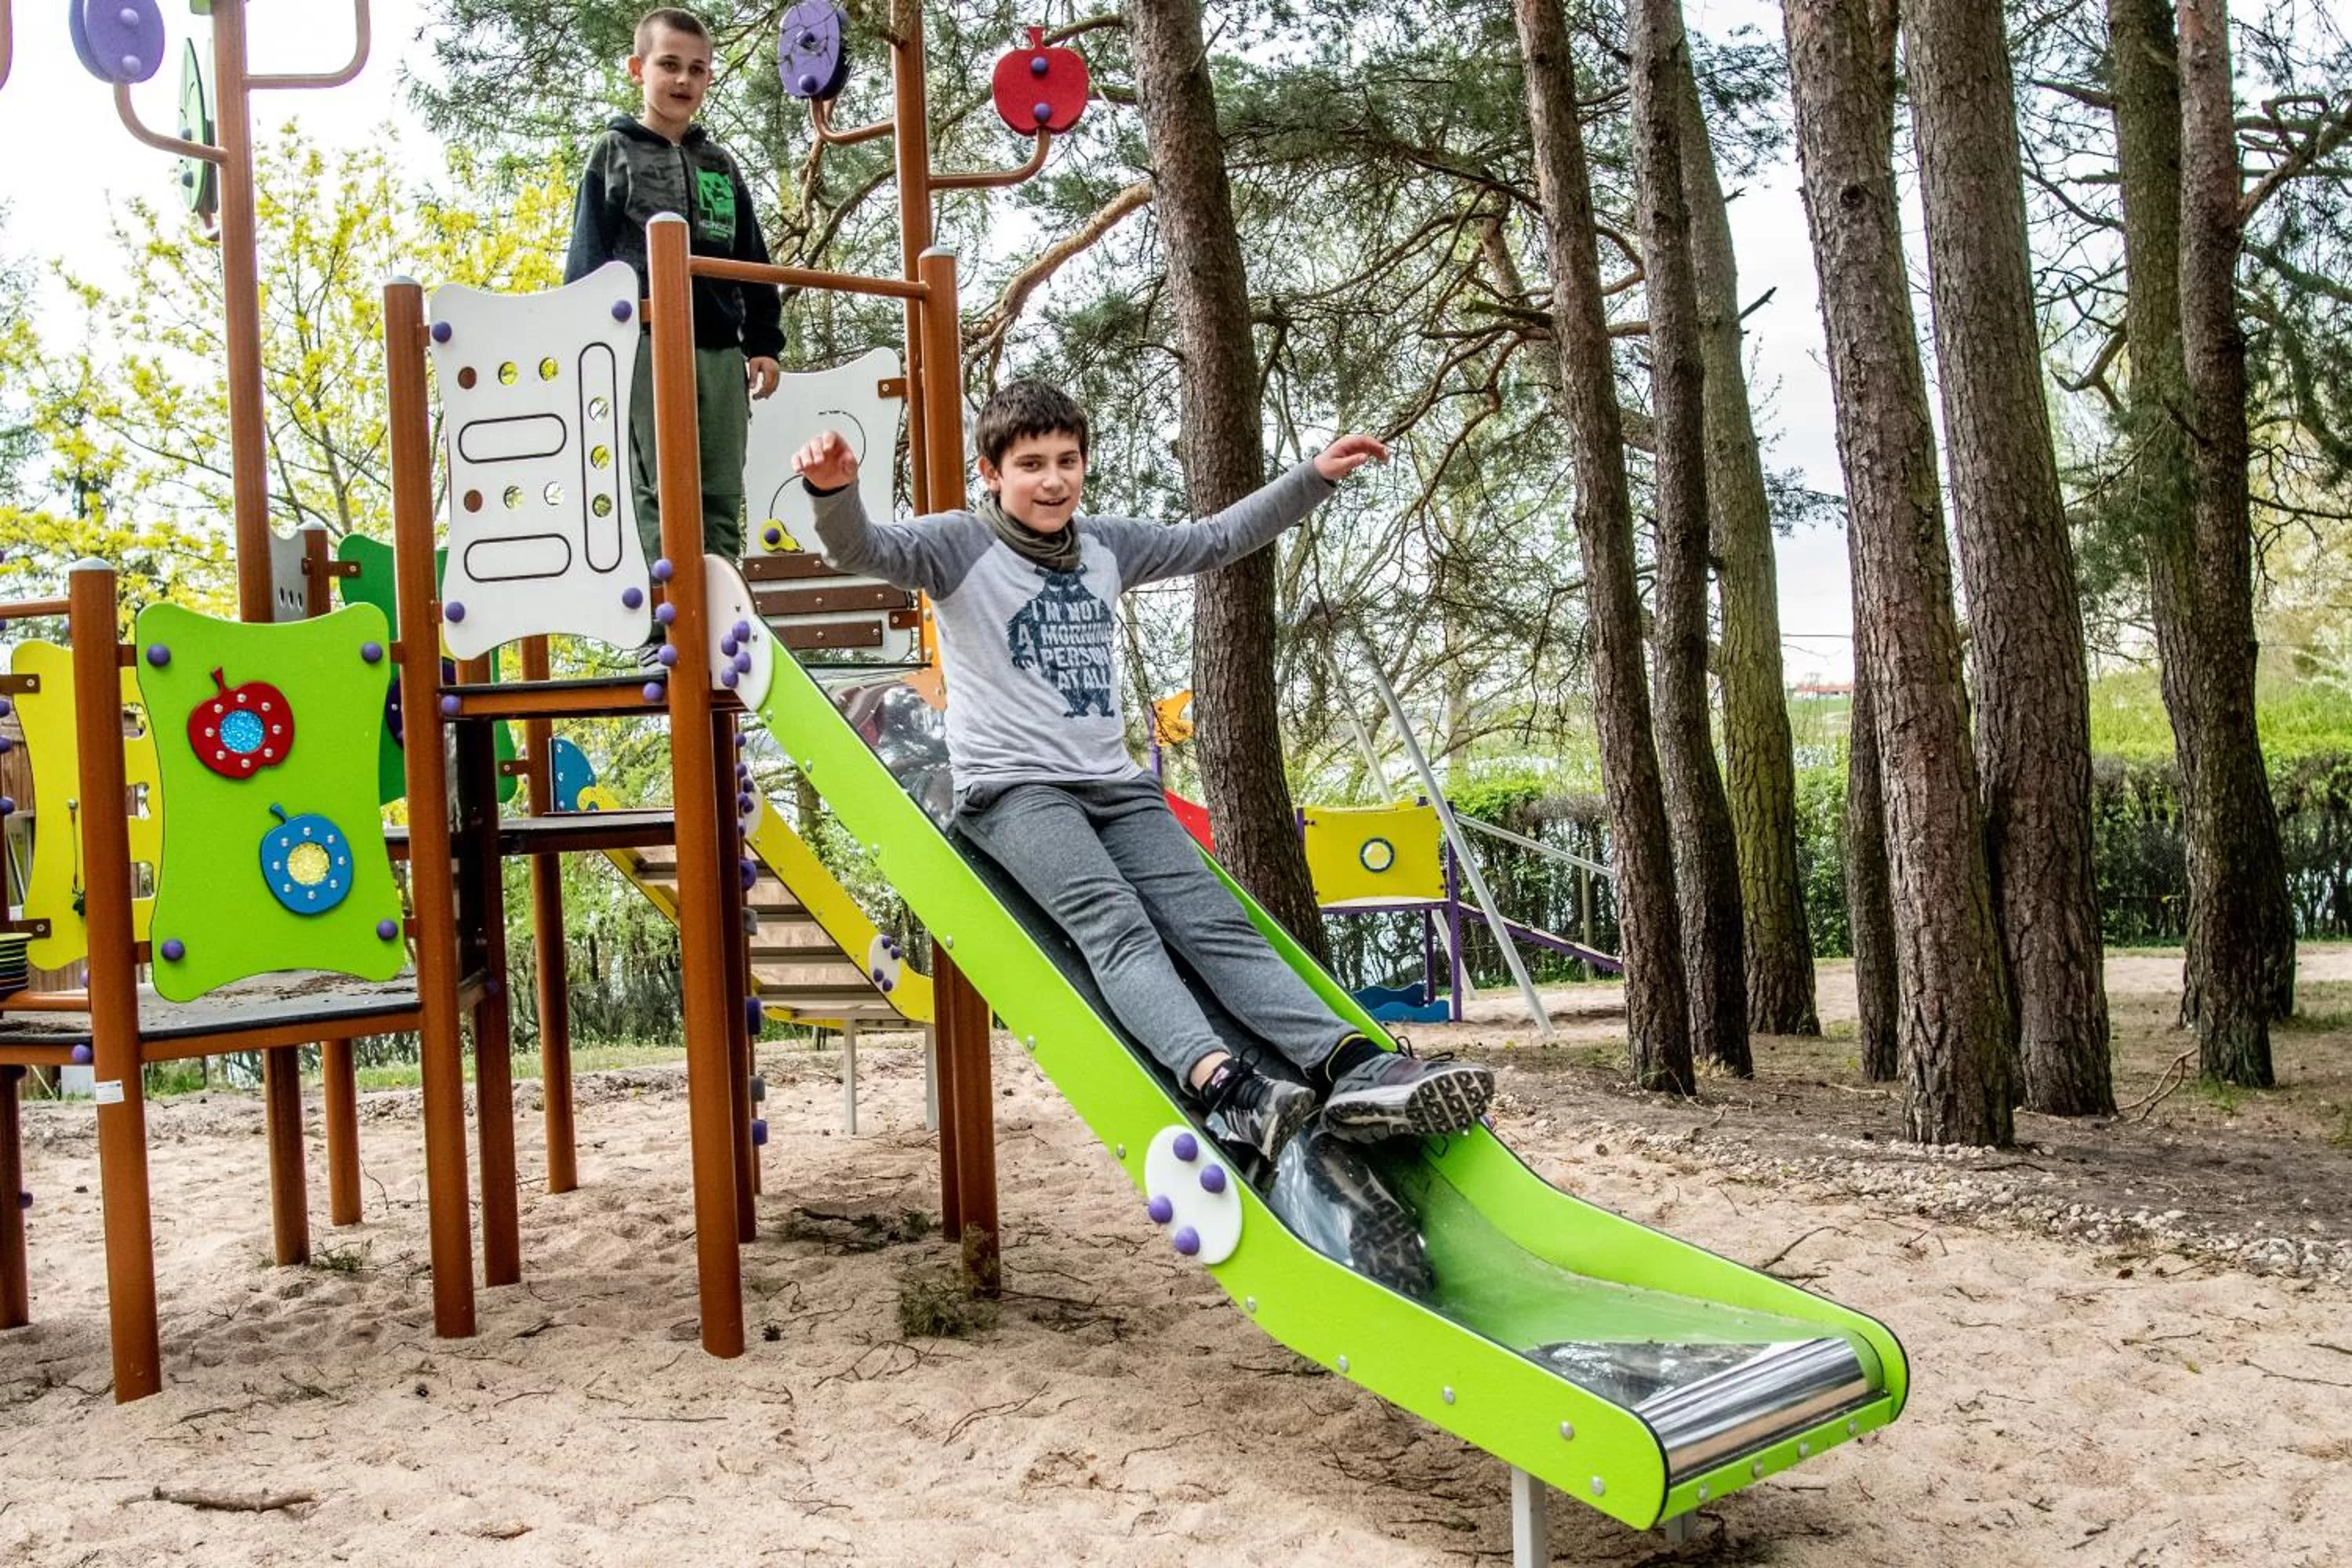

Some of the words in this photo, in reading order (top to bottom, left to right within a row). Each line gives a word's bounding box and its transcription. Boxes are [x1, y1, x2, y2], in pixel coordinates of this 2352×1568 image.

[1031, 599, 1062, 622] I'M
[1066, 599, 1102, 622] NOT
[1018, 623, 1033, 646] A
[1040, 622, 1113, 644] MORNING
[1040, 645, 1111, 668] PERSON
[1058, 669, 1079, 691] AT
[1083, 667, 1111, 689] ALL
